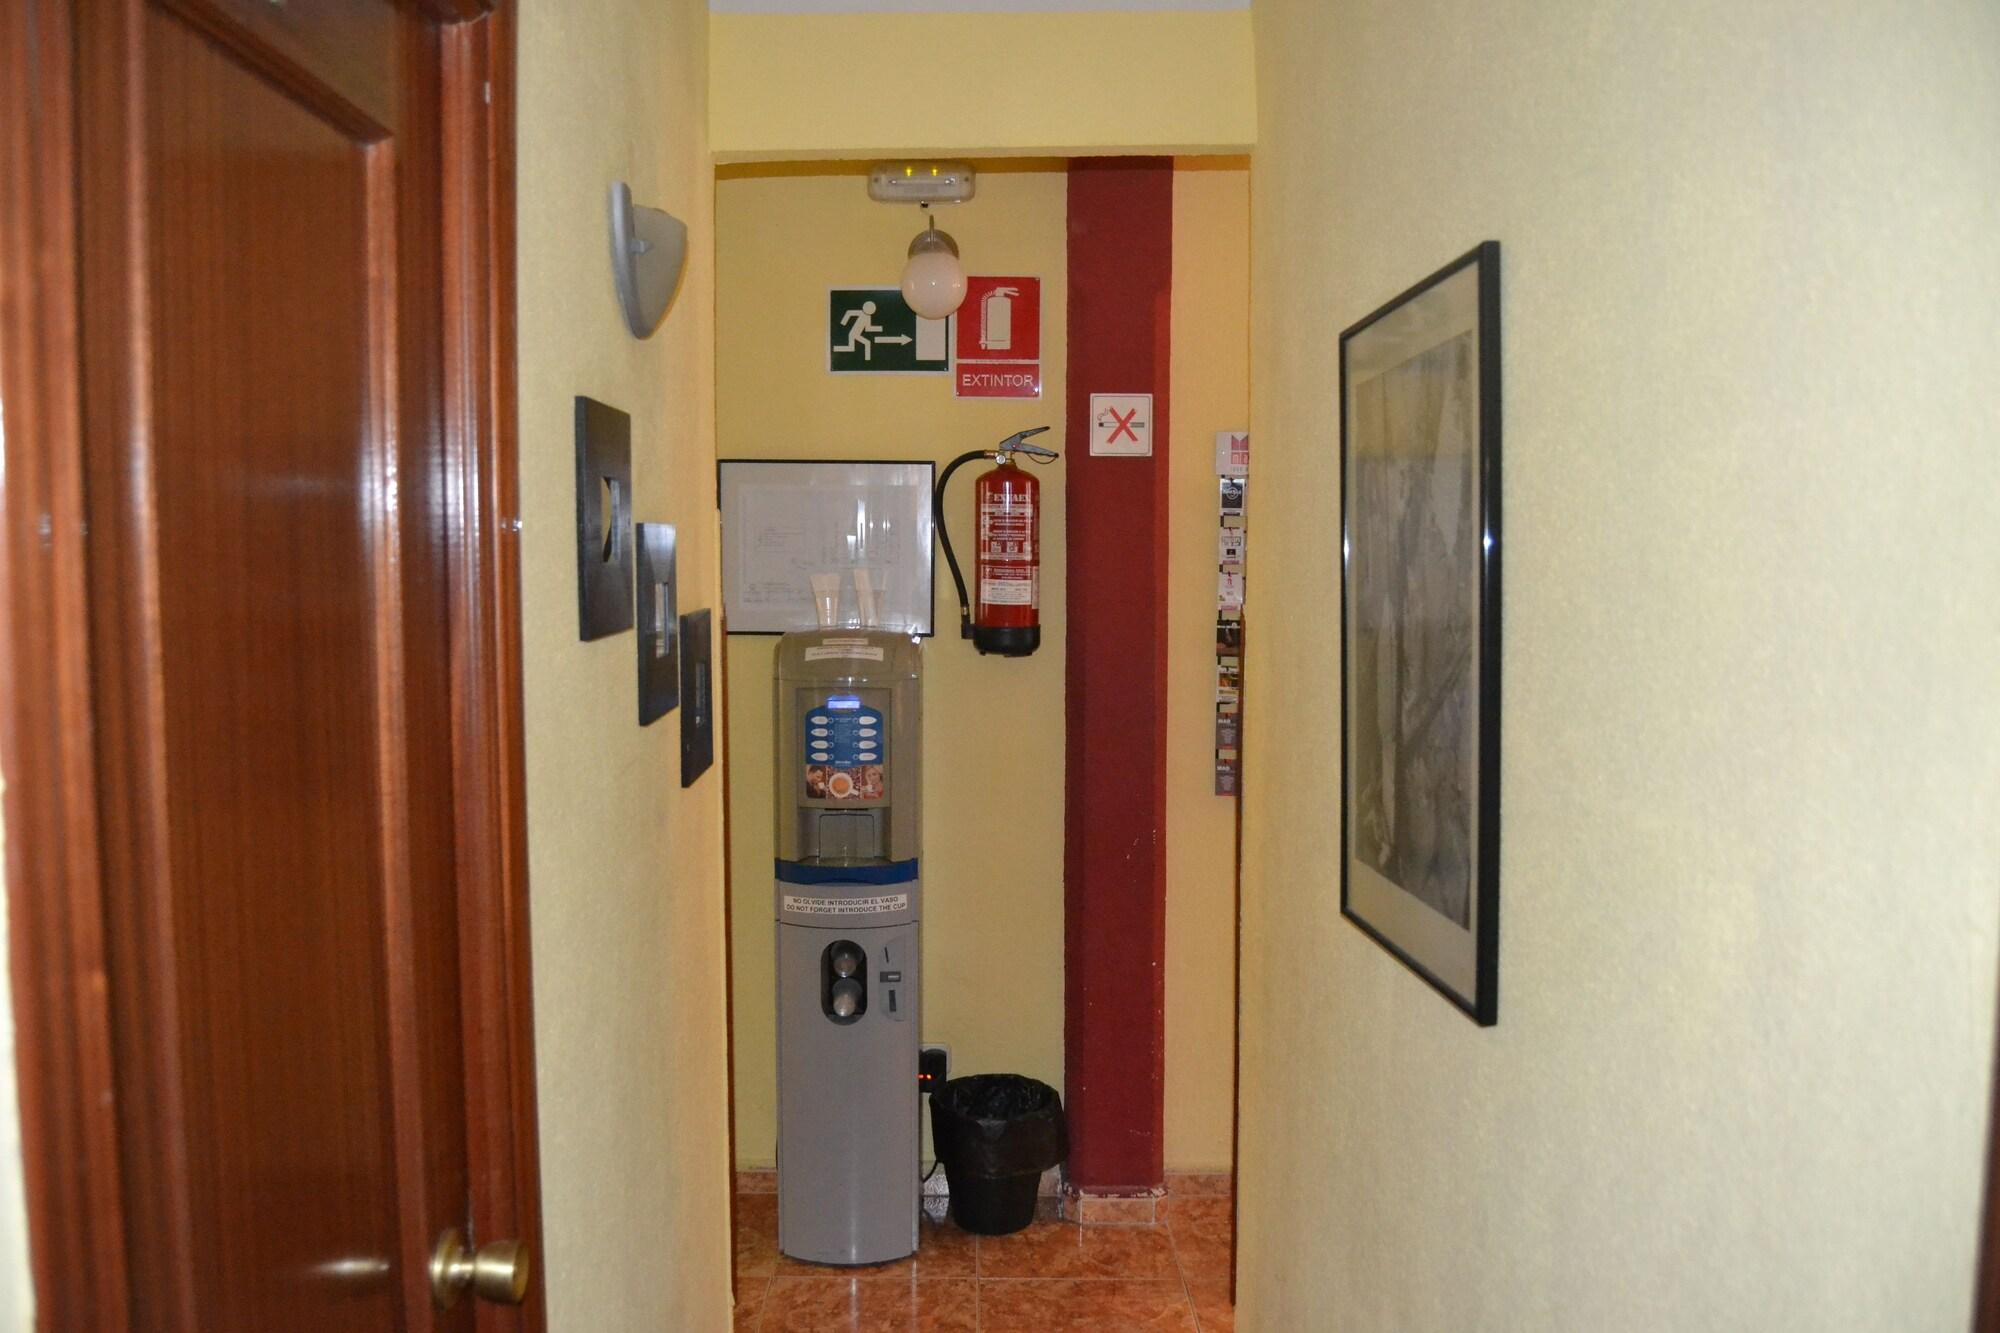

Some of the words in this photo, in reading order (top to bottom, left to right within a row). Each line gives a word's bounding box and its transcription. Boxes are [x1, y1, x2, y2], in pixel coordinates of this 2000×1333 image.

[962, 374, 1034, 387] EXTINTOR
[802, 898, 825, 906] OLVIDE
[880, 896, 898, 904] VASO
[837, 905, 877, 913] INTRODUCE
